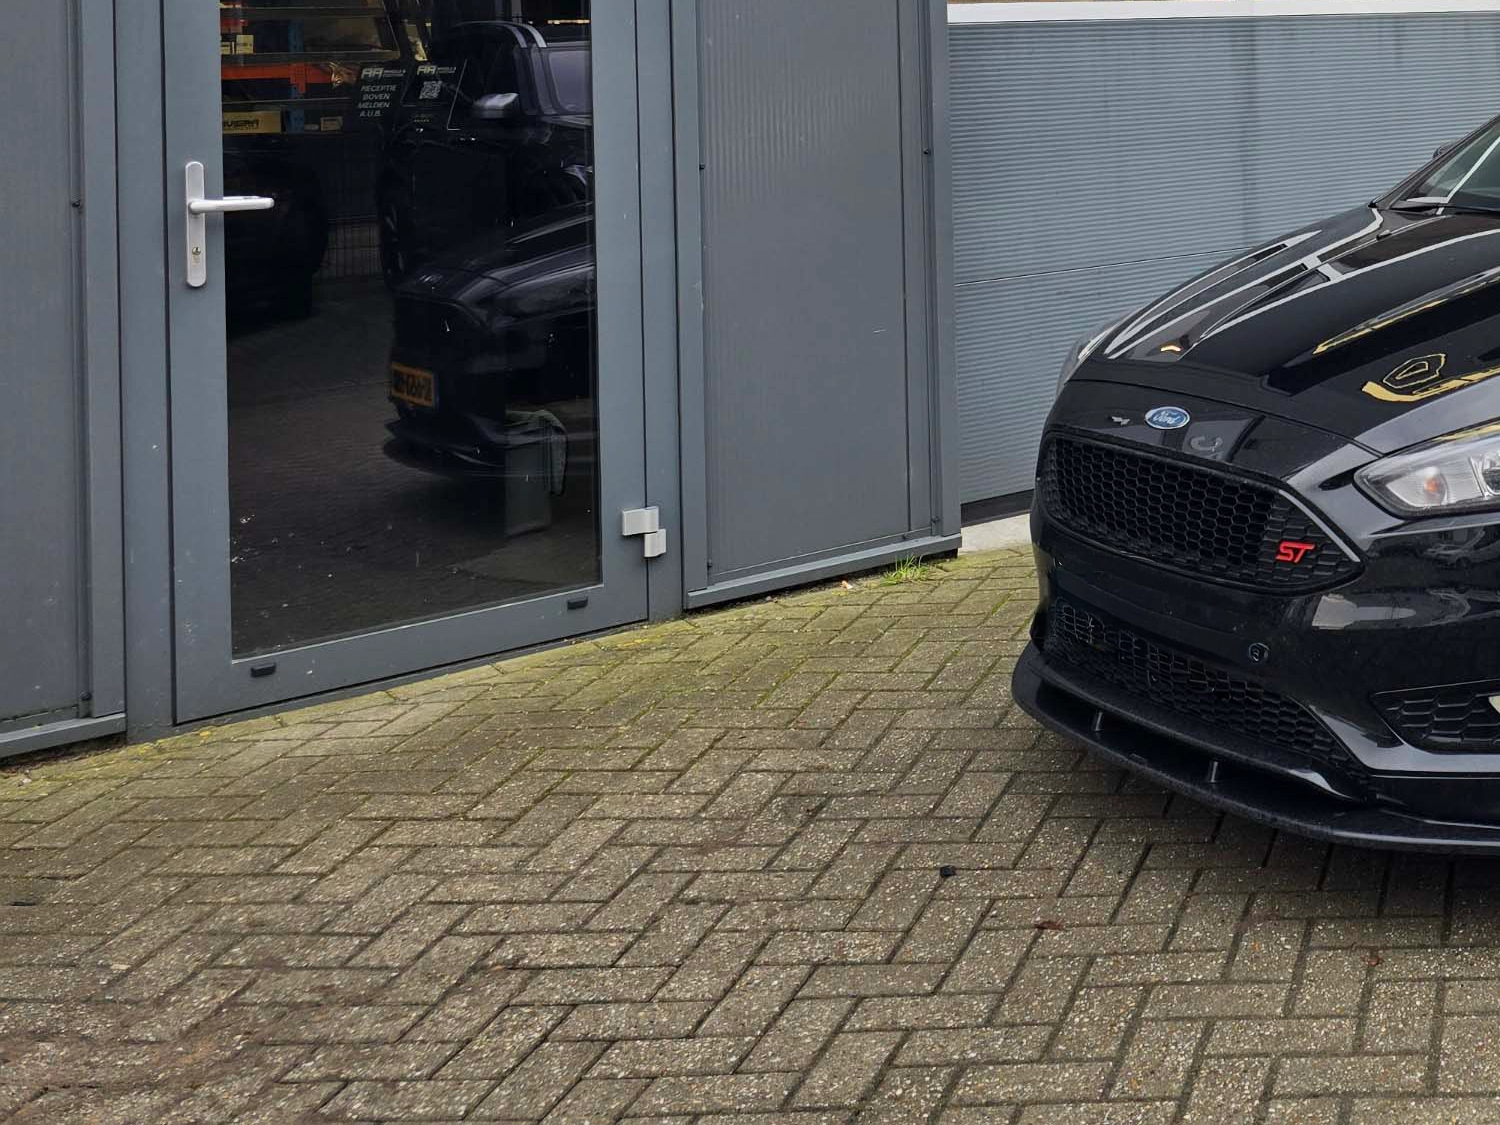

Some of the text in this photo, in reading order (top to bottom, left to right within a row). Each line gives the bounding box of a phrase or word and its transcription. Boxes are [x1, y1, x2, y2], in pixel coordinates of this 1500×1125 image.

[360, 84, 397, 92] RECEPTIE
[362, 93, 391, 101] BOVEN
[358, 101, 391, 109] MELDEN
[1151, 409, 1183, 426] Ford
[1275, 540, 1316, 564] ST
